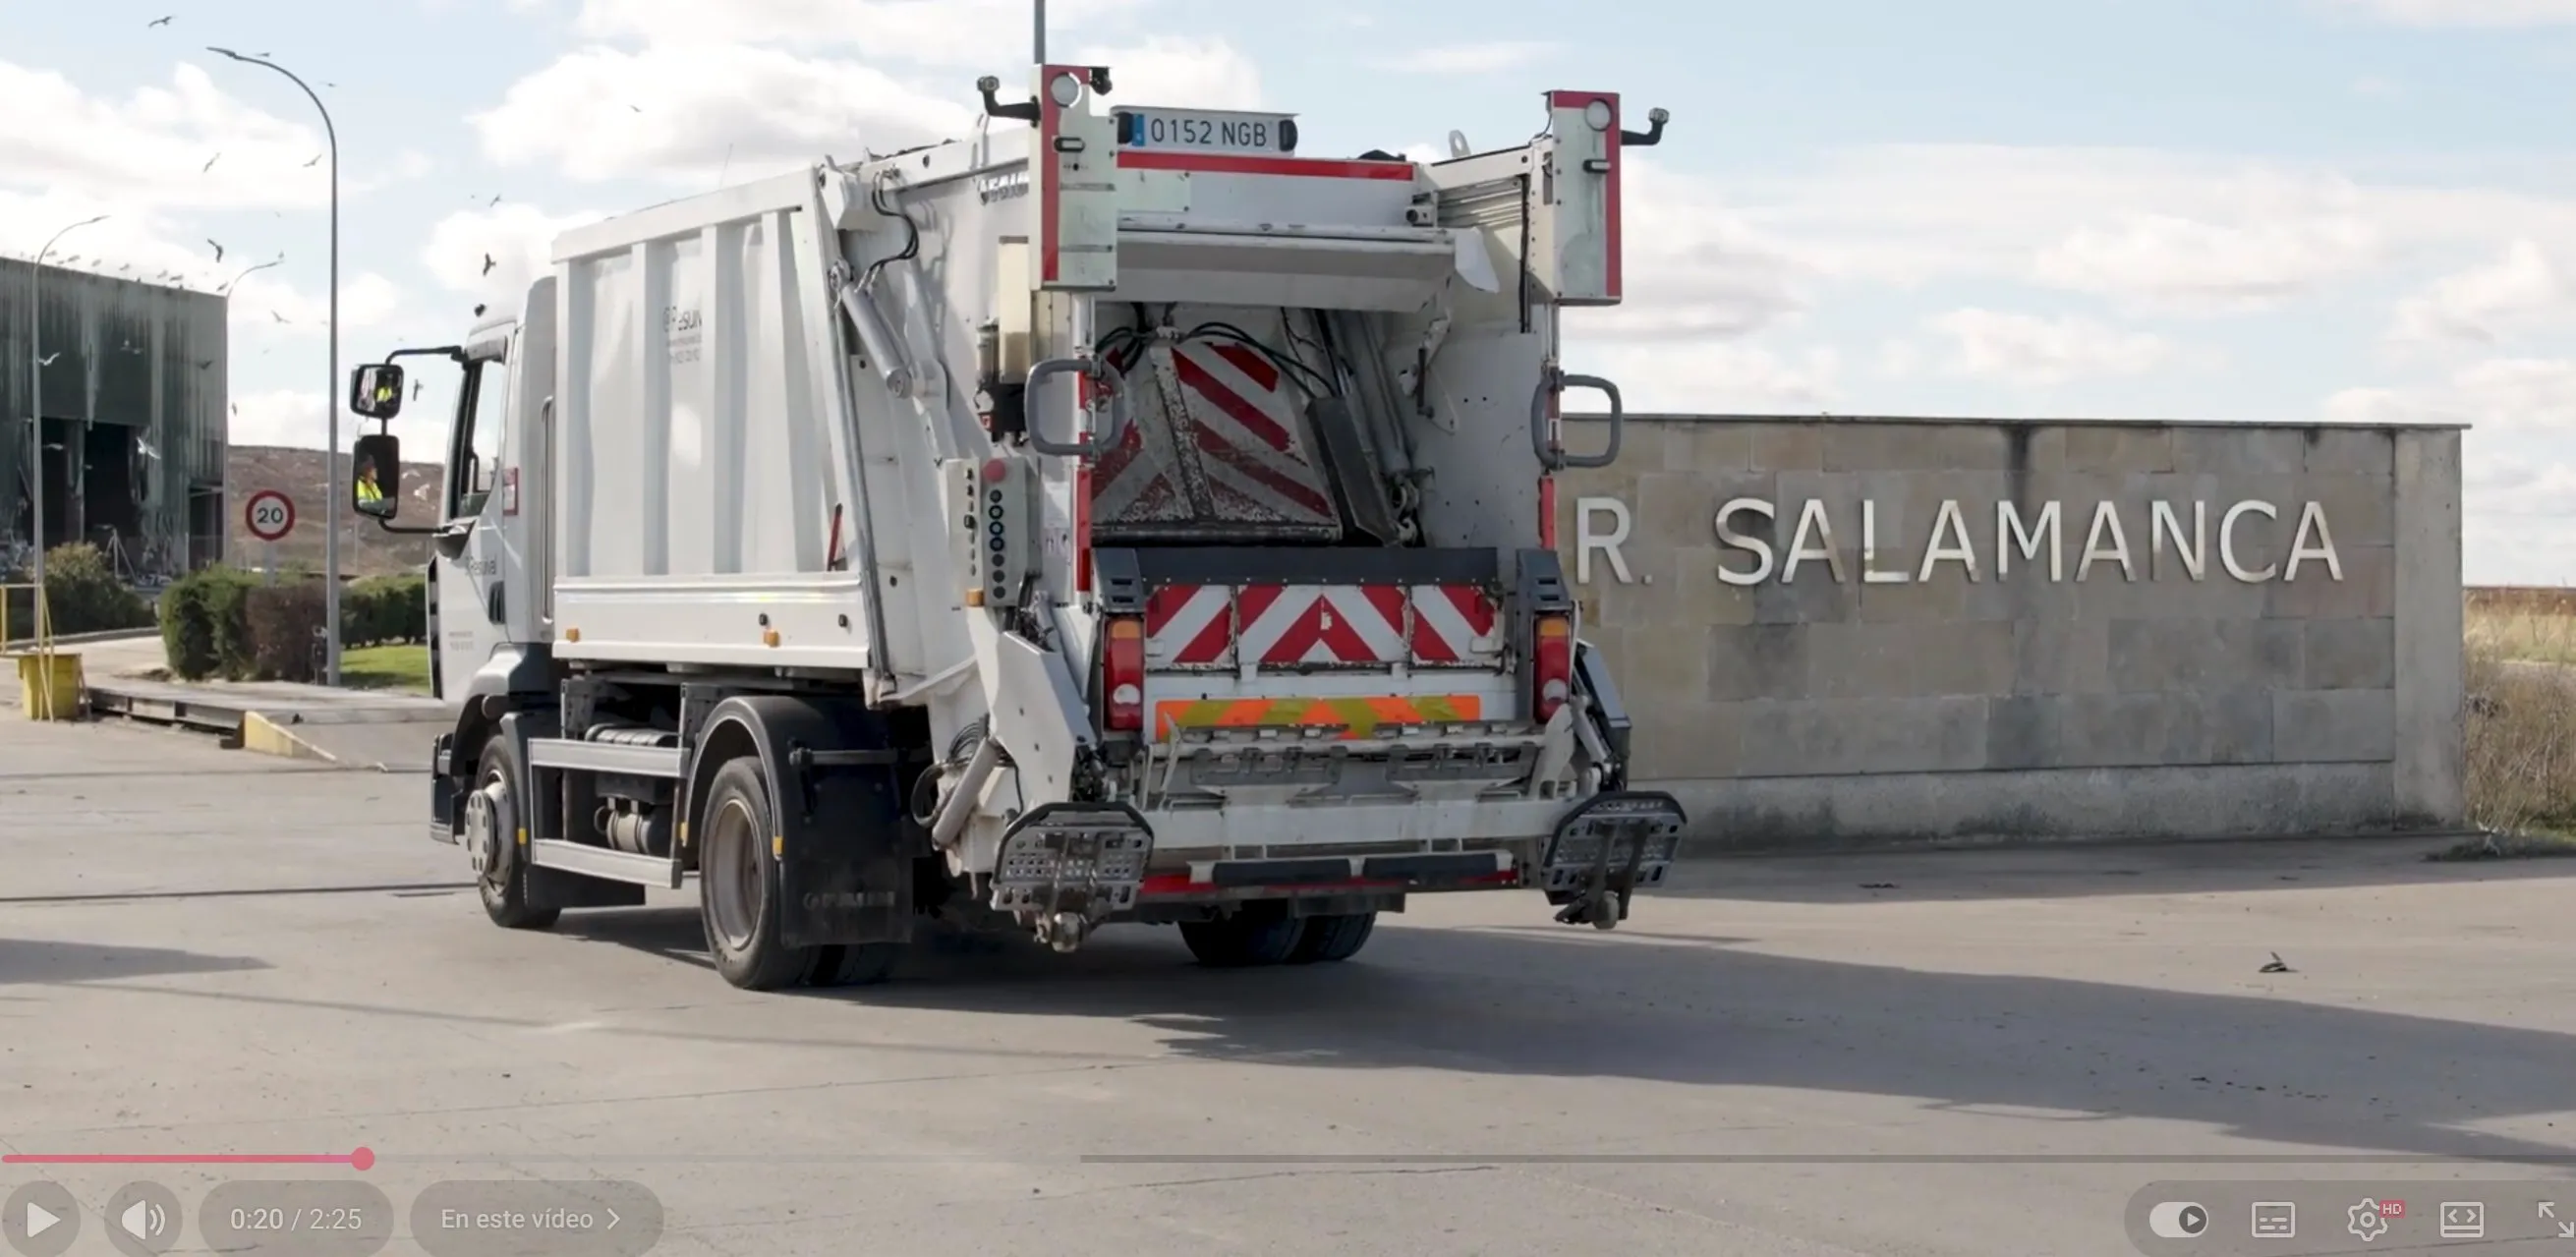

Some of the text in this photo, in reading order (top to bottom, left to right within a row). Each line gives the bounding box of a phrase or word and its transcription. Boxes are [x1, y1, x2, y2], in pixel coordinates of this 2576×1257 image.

[1151, 118, 1267, 146] 0152 NGB
[258, 507, 283, 524] 20
[1715, 499, 2344, 584] SALAMANCA
